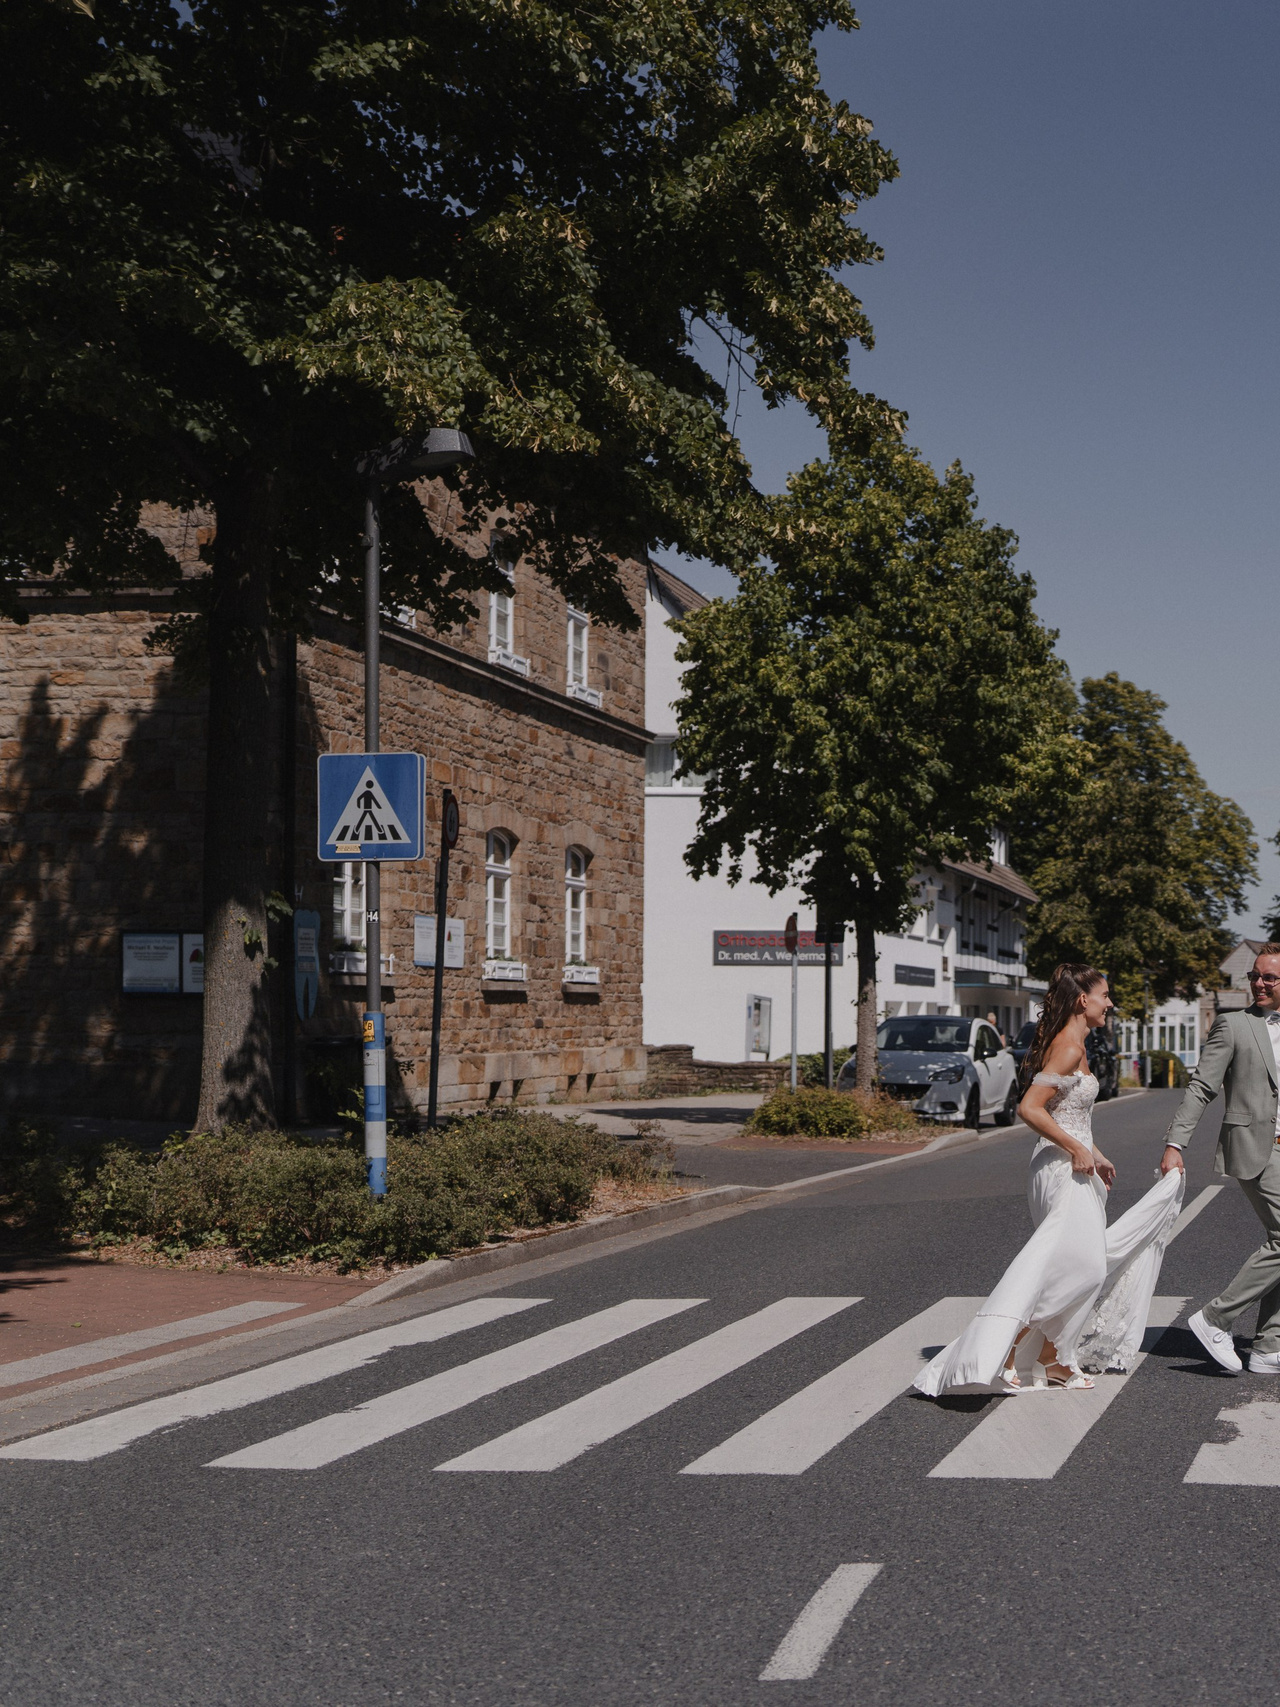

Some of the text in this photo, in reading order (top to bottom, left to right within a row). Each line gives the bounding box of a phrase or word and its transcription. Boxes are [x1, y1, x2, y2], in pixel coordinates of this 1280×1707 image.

[366, 911, 379, 922] H4
[718, 951, 731, 960] Dr.
[733, 951, 760, 961] med.
[762, 952, 774, 960] A.
